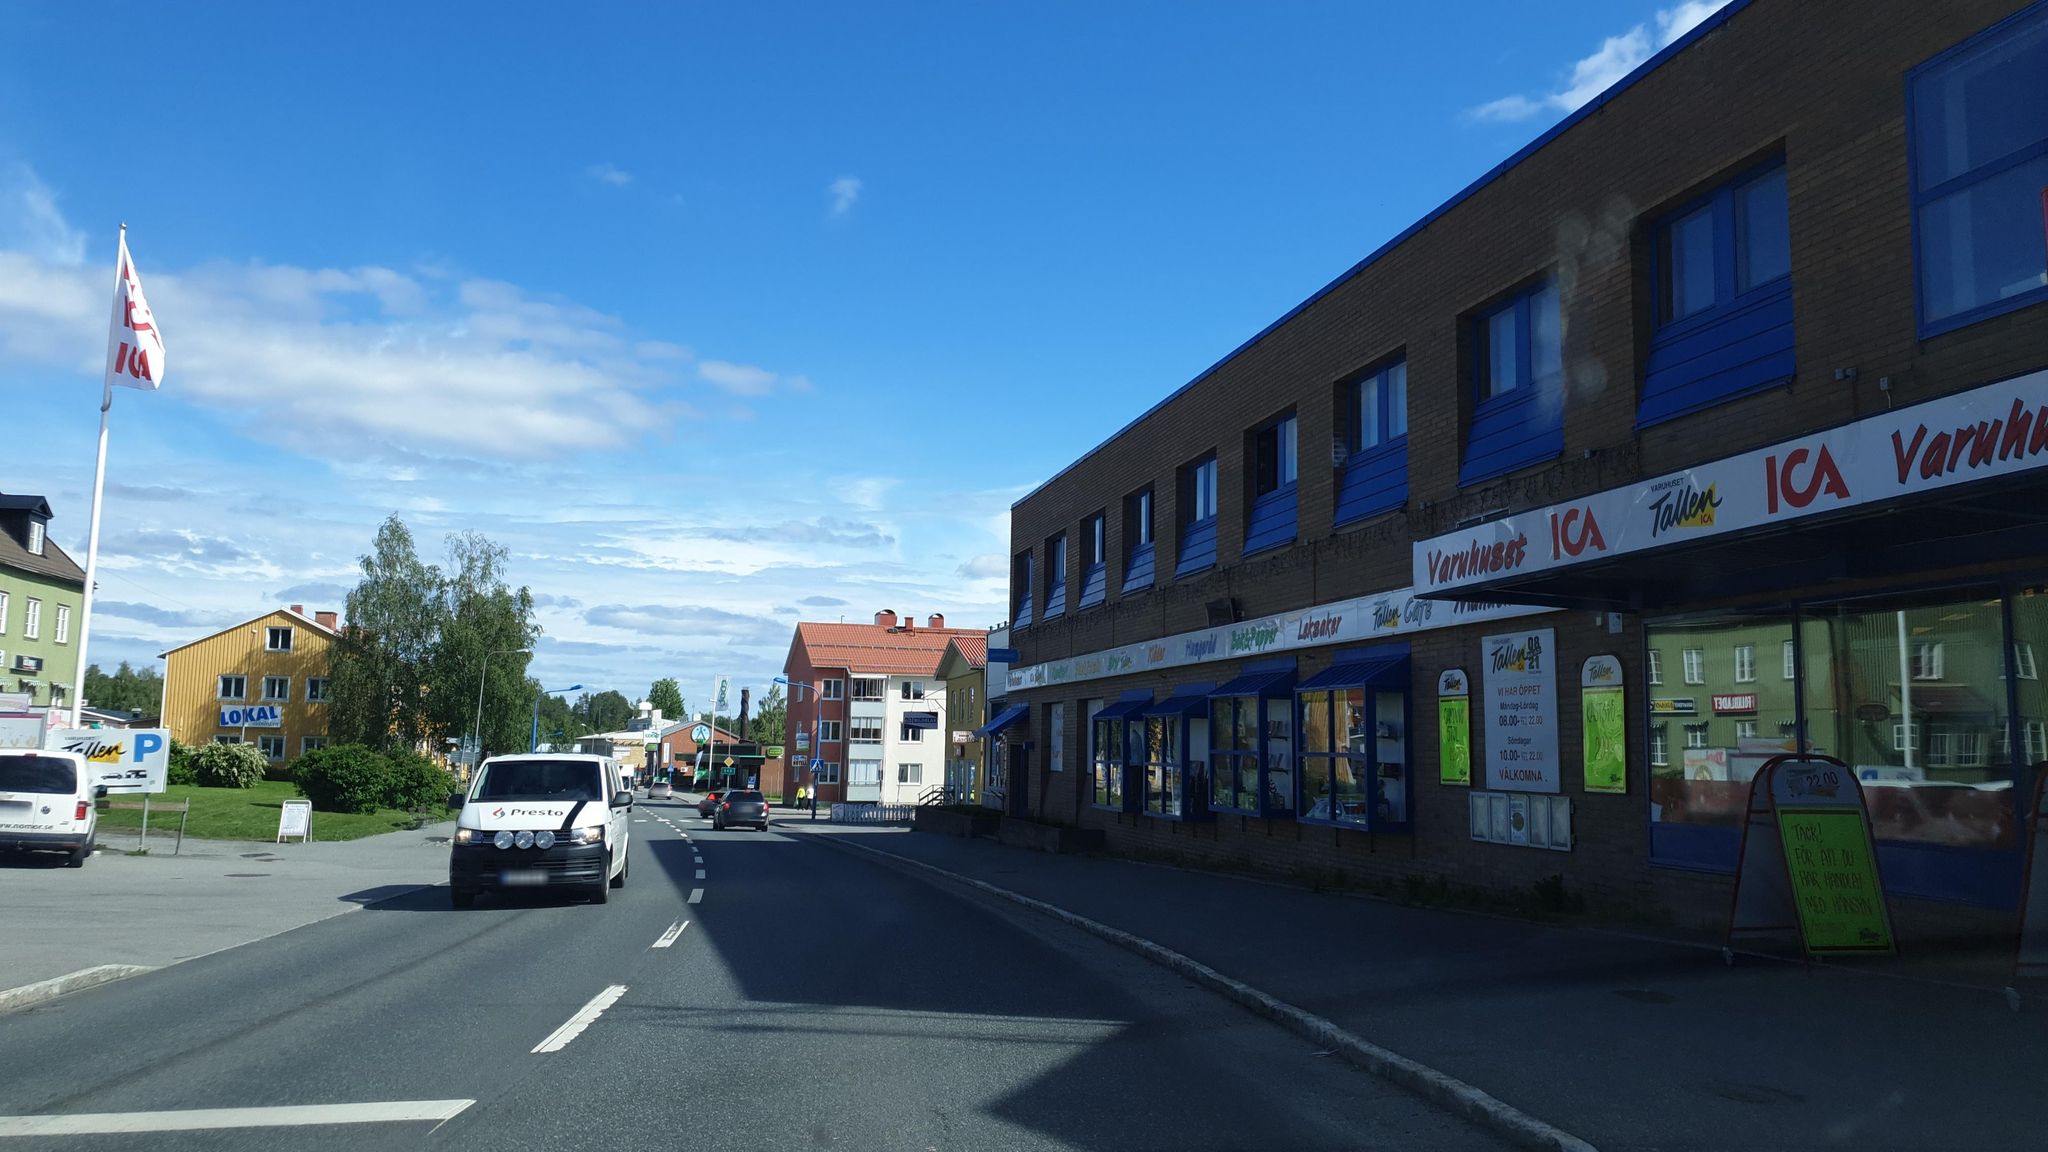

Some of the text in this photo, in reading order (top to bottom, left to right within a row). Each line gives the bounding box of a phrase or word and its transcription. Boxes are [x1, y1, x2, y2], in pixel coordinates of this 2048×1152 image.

[115, 342, 152, 381] ICA
[1650, 477, 1684, 494] VARUHUSET
[1765, 443, 1850, 515] ICA
[1648, 485, 1723, 538] Tallen
[1700, 513, 1713, 526] ICA
[1551, 505, 1607, 561] ICA
[1427, 532, 1527, 587] Varuhuset
[1297, 612, 1342, 641] Leksaker
[1373, 604, 1402, 631] Tallen
[1528, 636, 1540, 650] 08
[1491, 643, 1527, 675] Tallen
[1443, 675, 1461, 692] Tallen
[1588, 664, 1613, 683] Tallen
[1497, 684, 1541, 697] VI HAR ÖPPET
[220, 706, 278, 726] LOKAL
[133, 734, 162, 762] P
[1507, 736, 1531, 747] Söndagar
[1499, 767, 1543, 782] VÄLKOMNA
[510, 808, 564, 818] Presto
[1791, 822, 1823, 844] TACK!
